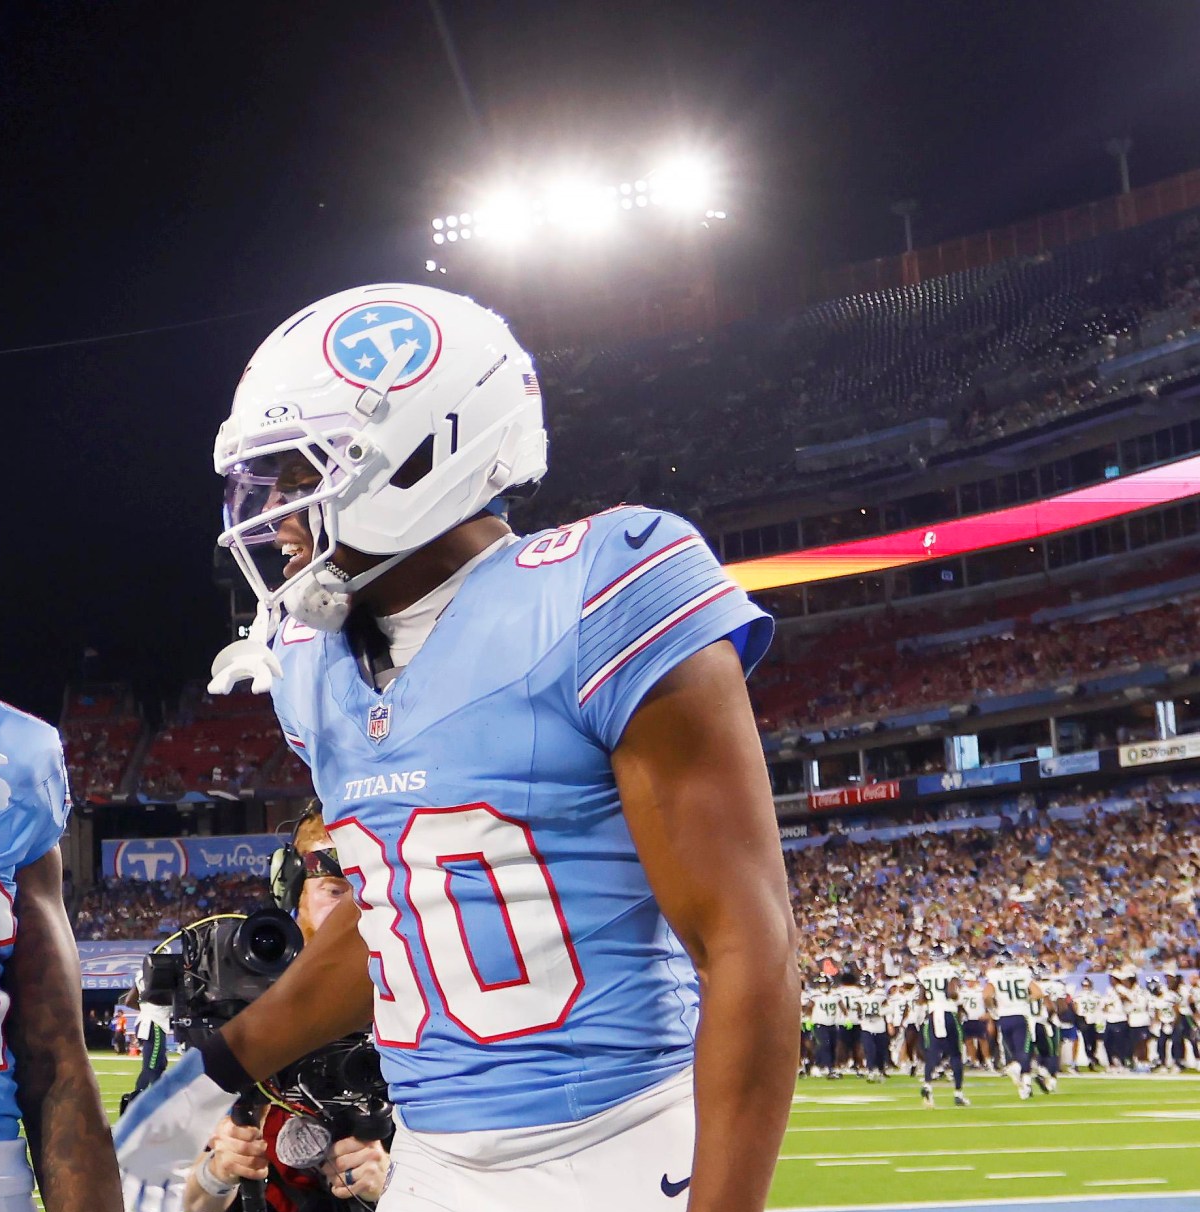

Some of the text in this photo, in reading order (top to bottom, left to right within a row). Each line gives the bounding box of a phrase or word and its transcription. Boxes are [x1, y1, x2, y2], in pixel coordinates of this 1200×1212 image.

[370, 721, 388, 736] NFL
[343, 769, 427, 800] TITANS
[779, 826, 807, 839] ONOR
[226, 844, 268, 876] Krog
[81, 978, 132, 988] ISSAN
[997, 979, 1028, 1000] 46
